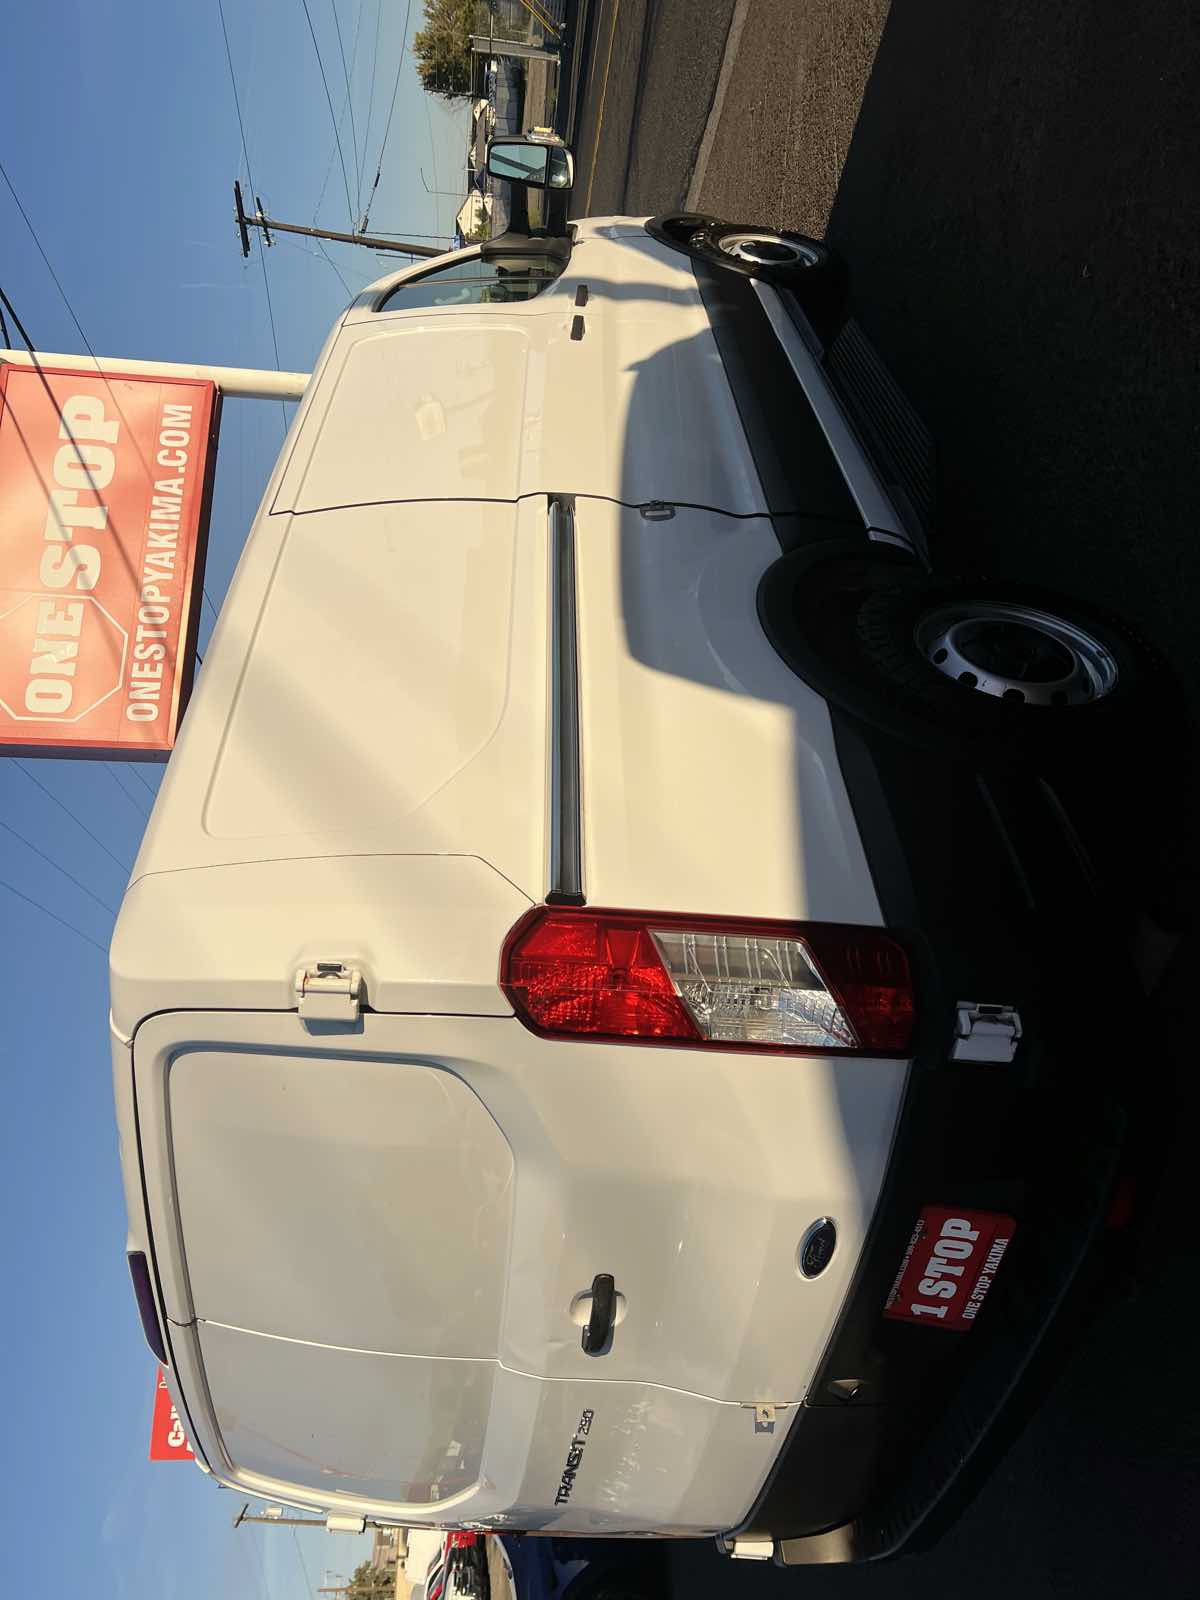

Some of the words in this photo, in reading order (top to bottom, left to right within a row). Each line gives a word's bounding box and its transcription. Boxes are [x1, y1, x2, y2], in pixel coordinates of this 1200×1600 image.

[39, 394, 120, 592] STOP
[126, 403, 193, 723] ONESTOPYAKIMA.COM
[24, 598, 85, 714] ONE
[918, 1218, 980, 1299] STOP
[970, 1275, 993, 1300] STOP
[982, 1238, 1009, 1275] YAKIMA
[910, 1303, 949, 1319] 1
[962, 1301, 982, 1319] ONE
[554, 1433, 586, 1506] TRANSIT
